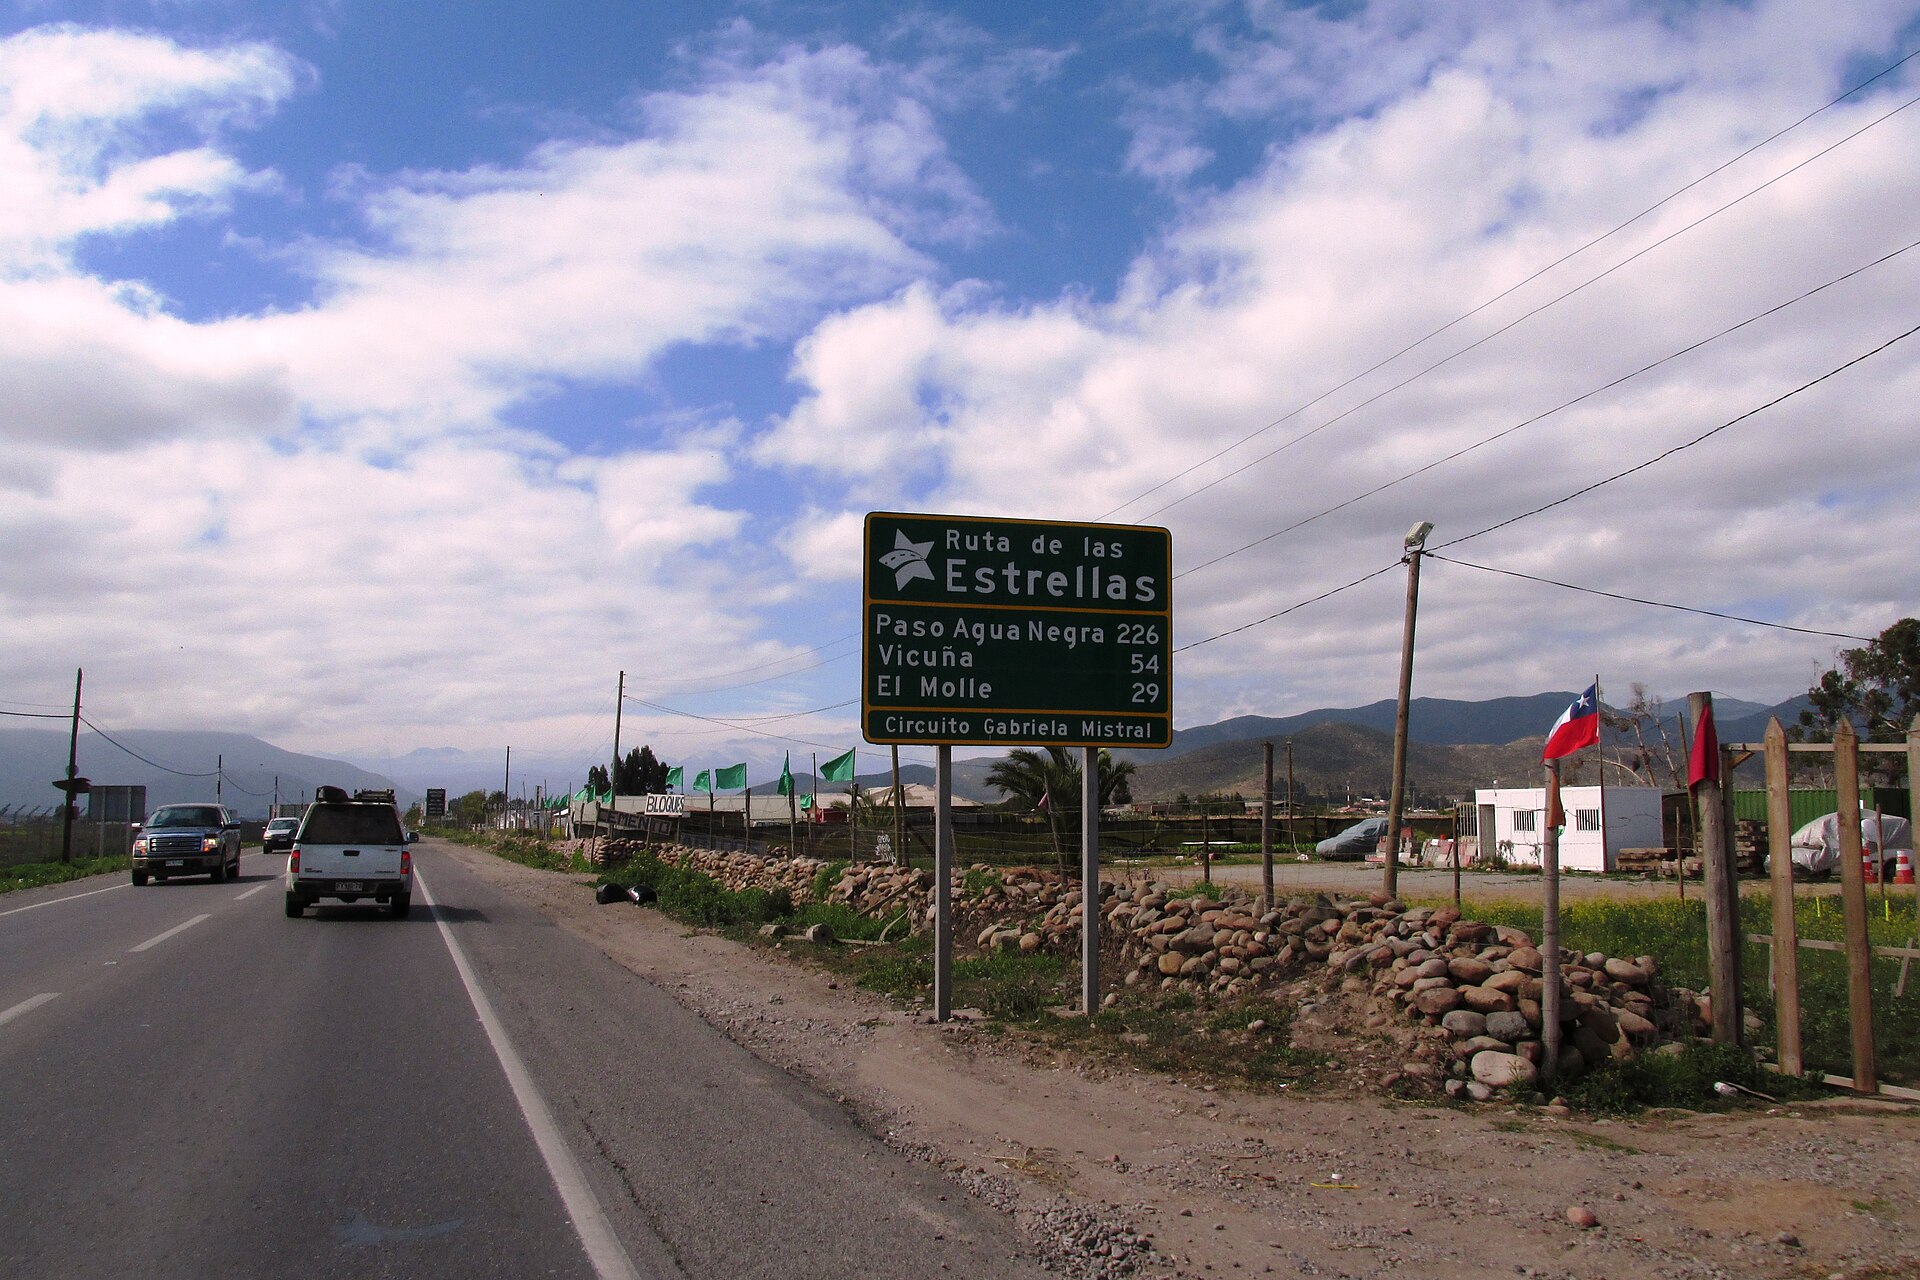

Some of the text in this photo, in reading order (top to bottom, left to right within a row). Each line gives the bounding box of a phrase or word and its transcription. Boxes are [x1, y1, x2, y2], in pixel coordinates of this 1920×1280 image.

[947, 530, 1122, 558] Ruta de las
[947, 558, 1155, 601] Estrellas
[876, 614, 1159, 649] Paso Agua Negra 226
[879, 644, 1159, 674] Vicuña 54
[878, 675, 1158, 703] El Molle 29
[886, 717, 1150, 737] Circuito Gabriela Mistral
[646, 795, 684, 813] BLOQUES
